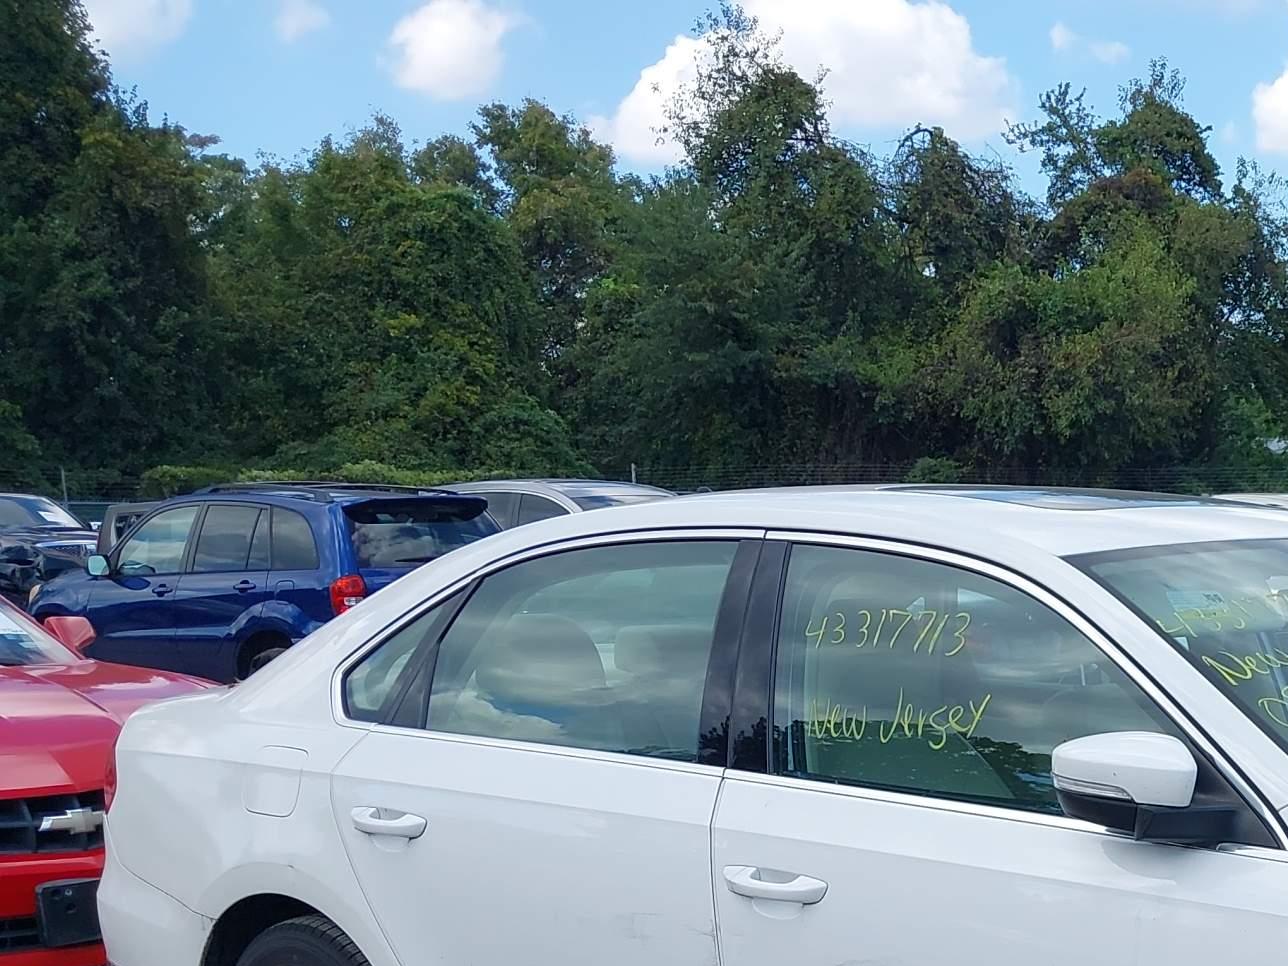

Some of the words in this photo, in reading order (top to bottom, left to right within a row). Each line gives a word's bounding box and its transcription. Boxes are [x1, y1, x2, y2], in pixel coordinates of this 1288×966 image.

[805, 608, 971, 657] 43317713
[808, 697, 867, 741] New
[879, 687, 992, 750] Jersey
